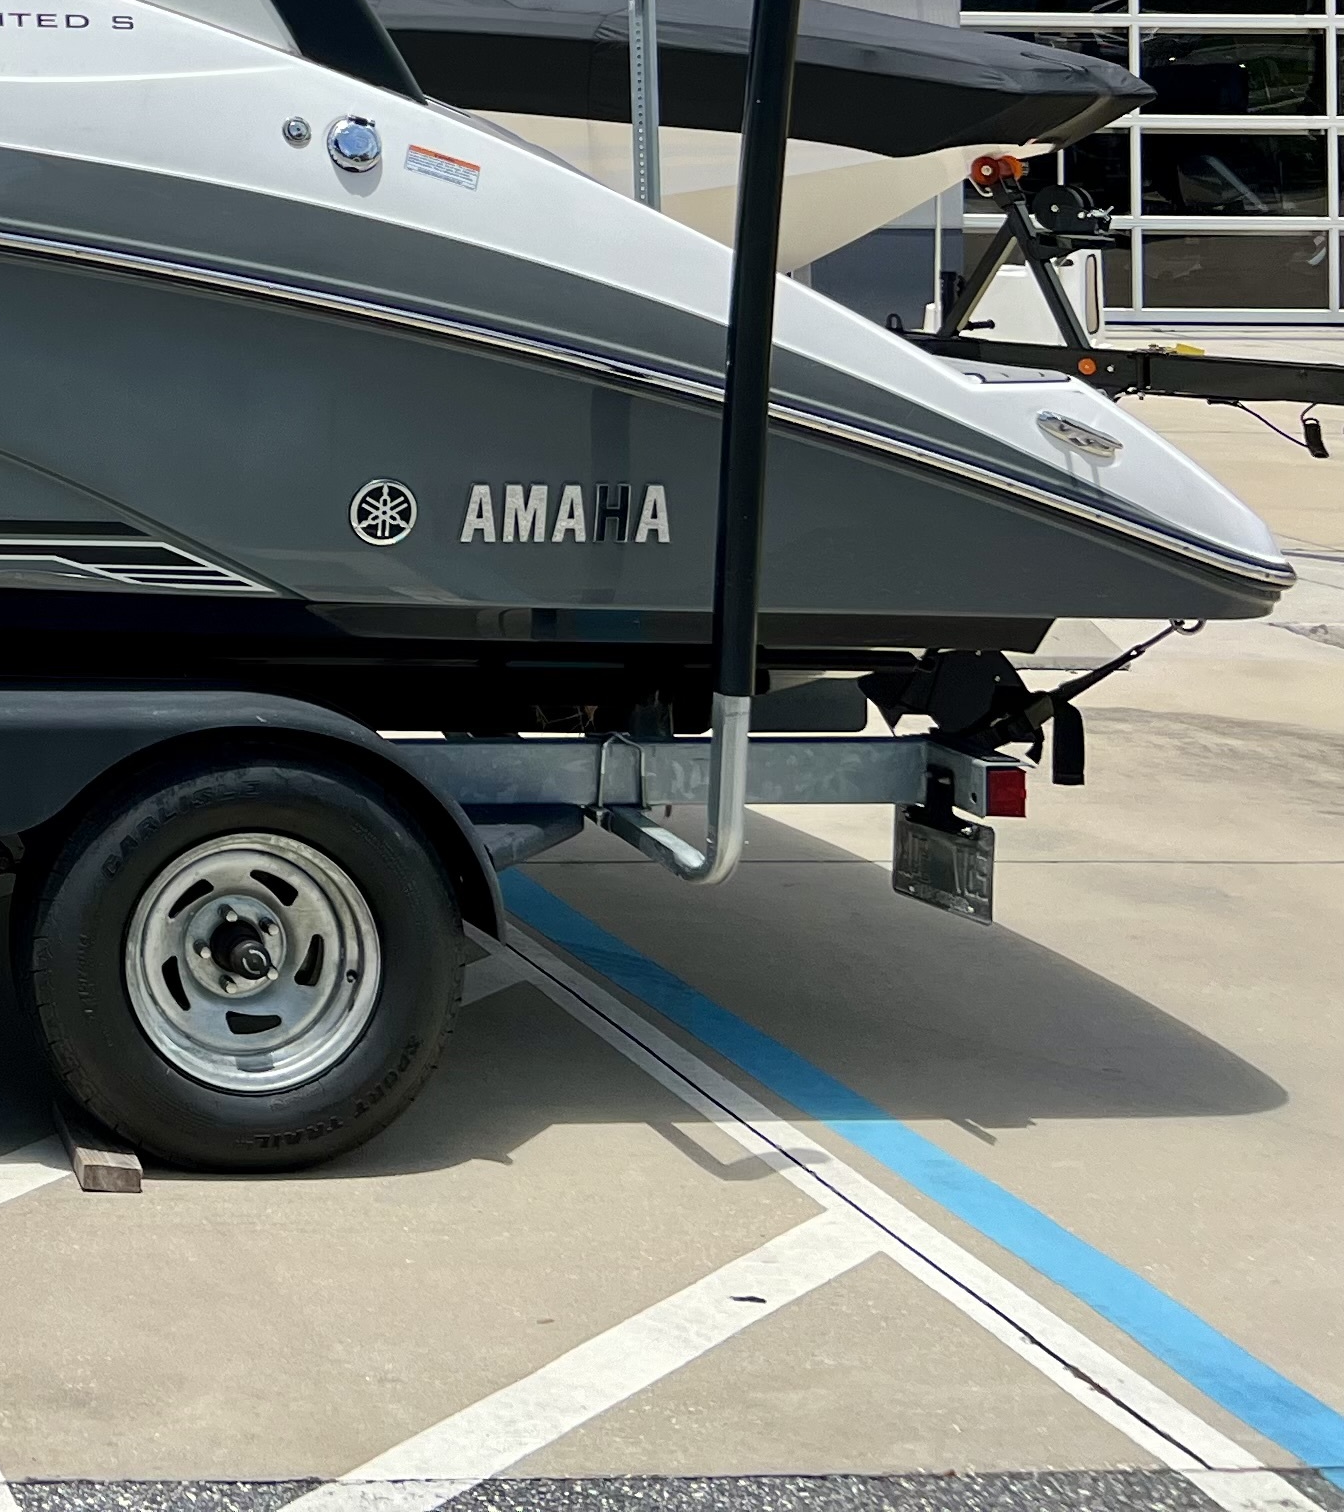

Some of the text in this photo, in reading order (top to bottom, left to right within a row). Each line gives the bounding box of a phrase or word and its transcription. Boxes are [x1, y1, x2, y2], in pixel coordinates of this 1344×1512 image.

[111, 15, 135, 30] S
[460, 483, 671, 543] AMAHA
[101, 779, 262, 880] CARLISLE
